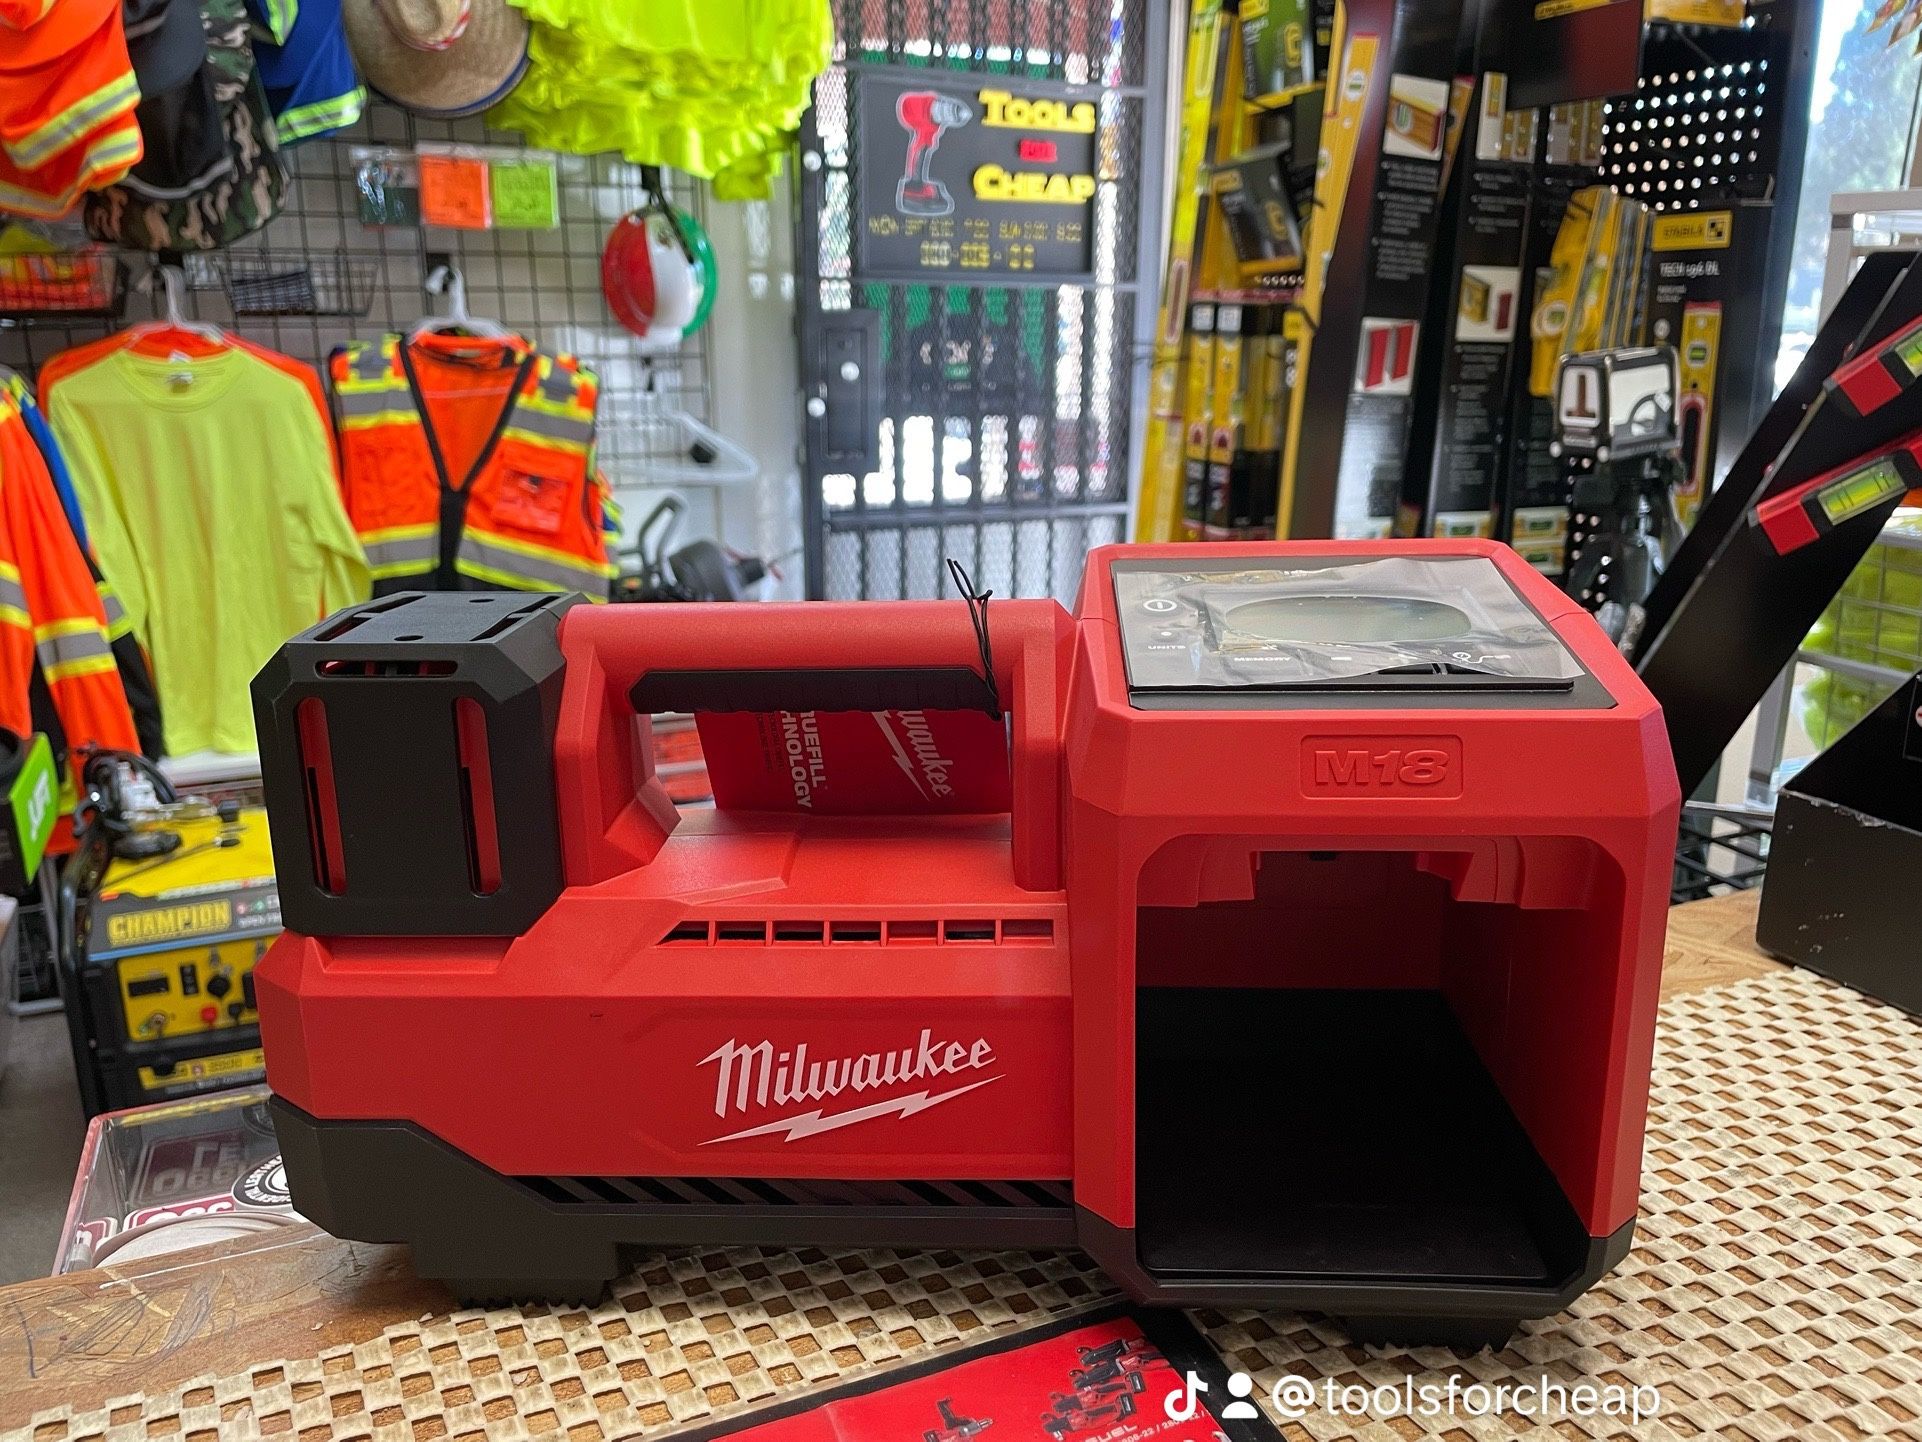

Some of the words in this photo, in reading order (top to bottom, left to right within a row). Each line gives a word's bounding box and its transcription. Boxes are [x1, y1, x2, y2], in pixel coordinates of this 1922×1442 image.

[979, 89, 1096, 134] TOOLS
[973, 163, 1096, 204] CHEAP
[1314, 750, 1449, 785] M18
[109, 900, 231, 944] CHAMPION
[696, 1029, 997, 1119] Milwaukee
